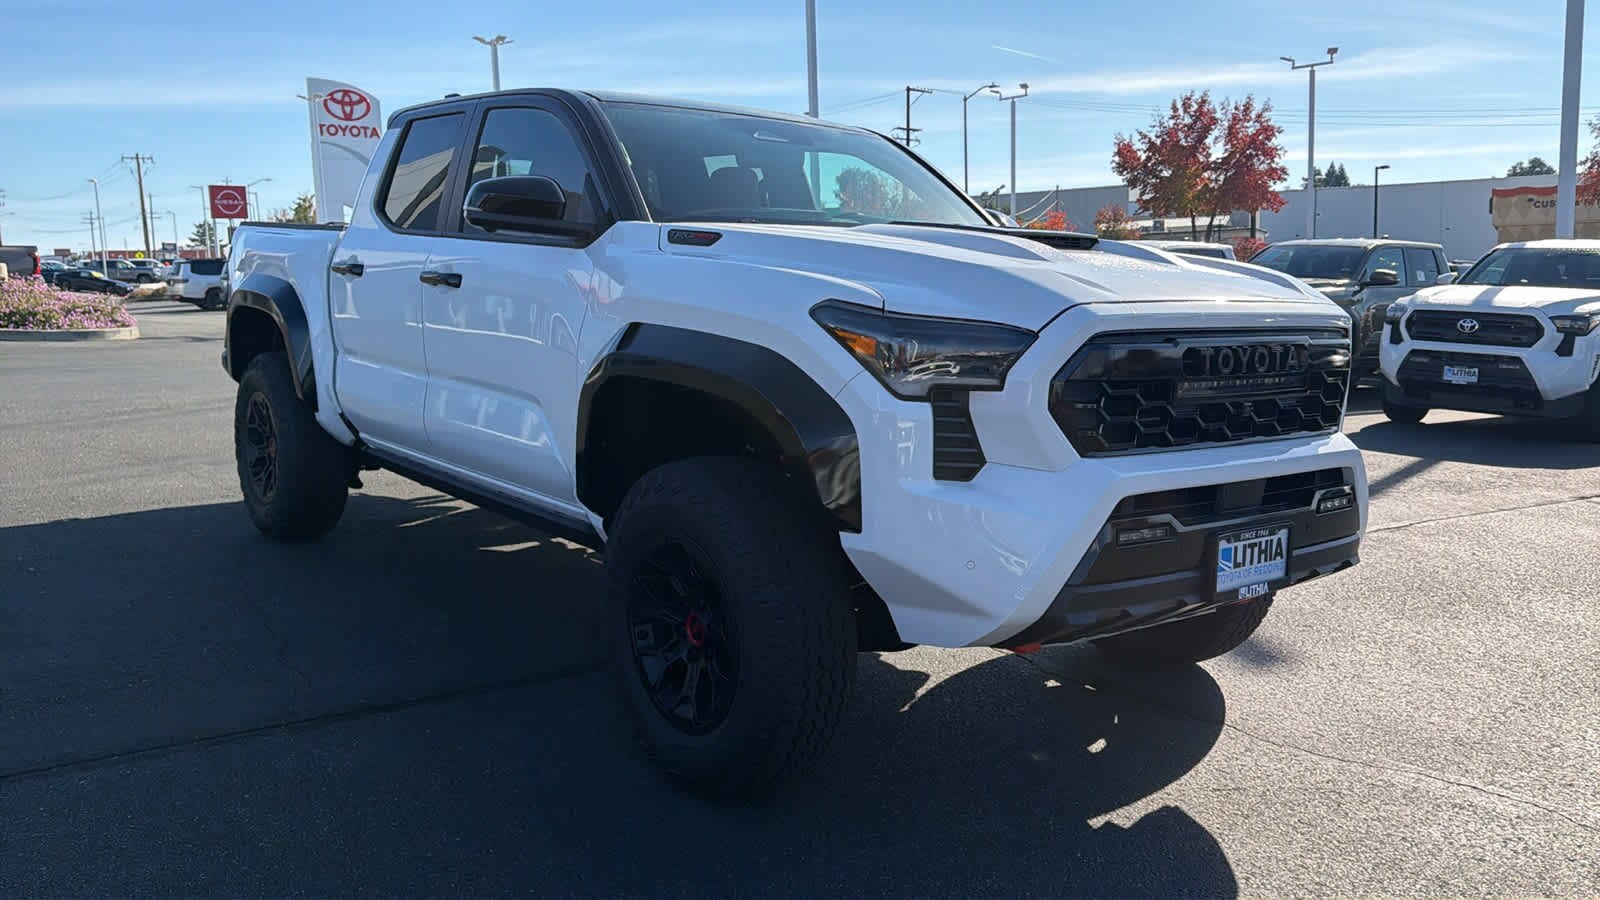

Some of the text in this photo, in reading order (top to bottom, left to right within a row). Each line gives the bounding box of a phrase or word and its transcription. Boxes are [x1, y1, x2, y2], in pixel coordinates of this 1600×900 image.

[318, 124, 381, 139] TOYOTA
[1200, 345, 1299, 373] TOYOTA
[1452, 368, 1477, 377] LITHIA
[1233, 537, 1284, 569] LITHIA
[1246, 582, 1269, 597] LITHIA
